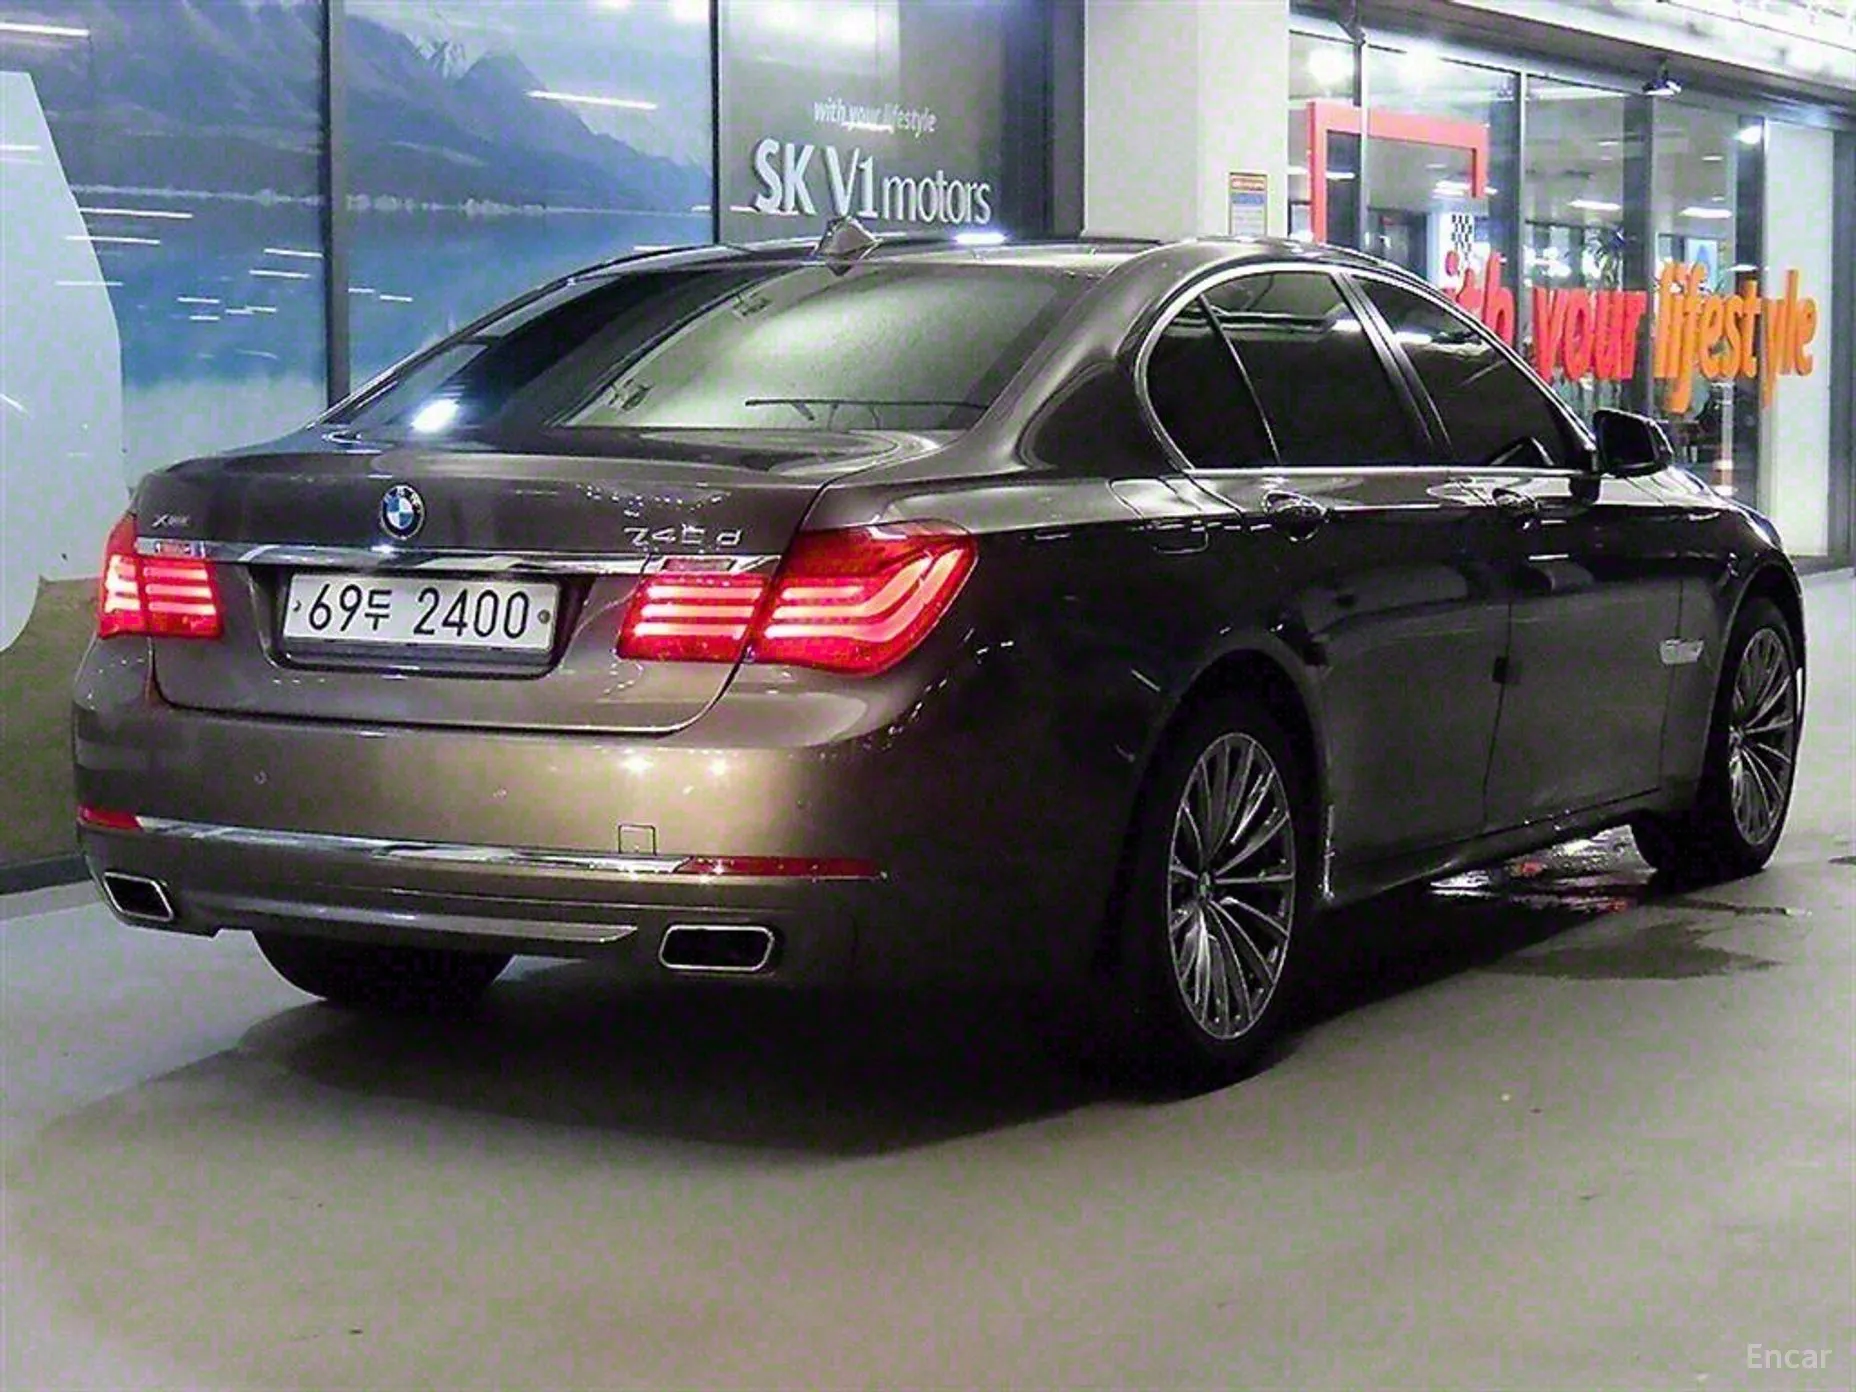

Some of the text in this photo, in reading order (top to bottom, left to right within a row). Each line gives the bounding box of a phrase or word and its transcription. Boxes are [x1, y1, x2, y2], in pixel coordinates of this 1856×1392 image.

[814, 97, 846, 122] with
[753, 138, 992, 225] SK V1 motors
[1533, 287, 1648, 382] your
[1654, 260, 1818, 415] lifestyle
[307, 583, 531, 640] 69두 2400
